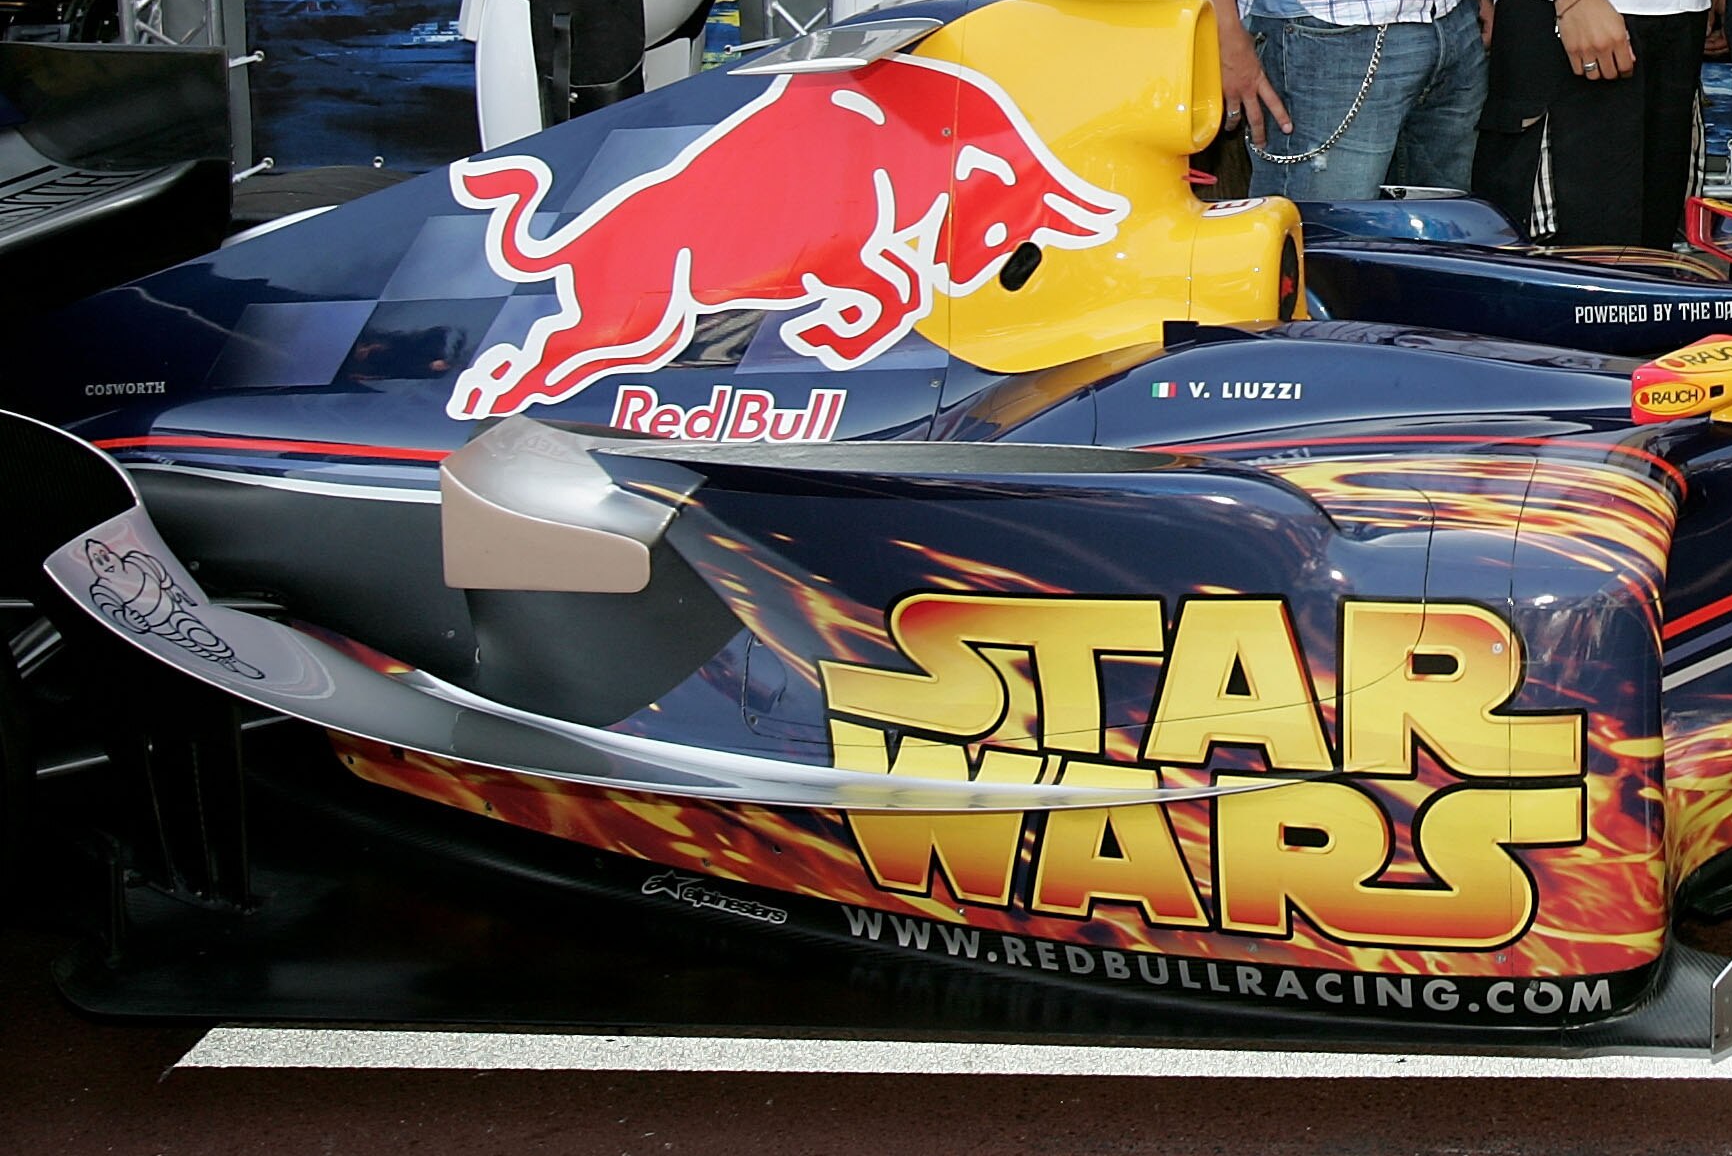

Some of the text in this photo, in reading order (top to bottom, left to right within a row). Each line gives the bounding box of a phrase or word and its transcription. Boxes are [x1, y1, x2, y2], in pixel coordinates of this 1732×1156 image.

[1575, 304, 1647, 324] POWERED
[1653, 303, 1673, 321] BY
[1678, 302, 1711, 322] THE
[85, 381, 166, 396] COSWORTH
[1189, 382, 1301, 400] V. LIUZZI
[1651, 389, 1698, 405] RAUCH
[611, 385, 847, 442] Red Bull
[820, 591, 1586, 781] STAR
[828, 718, 1586, 947] WARS
[682, 885, 787, 924] alpinestars
[841, 905, 1612, 1016] WWW.REDBULLRACING.COM
